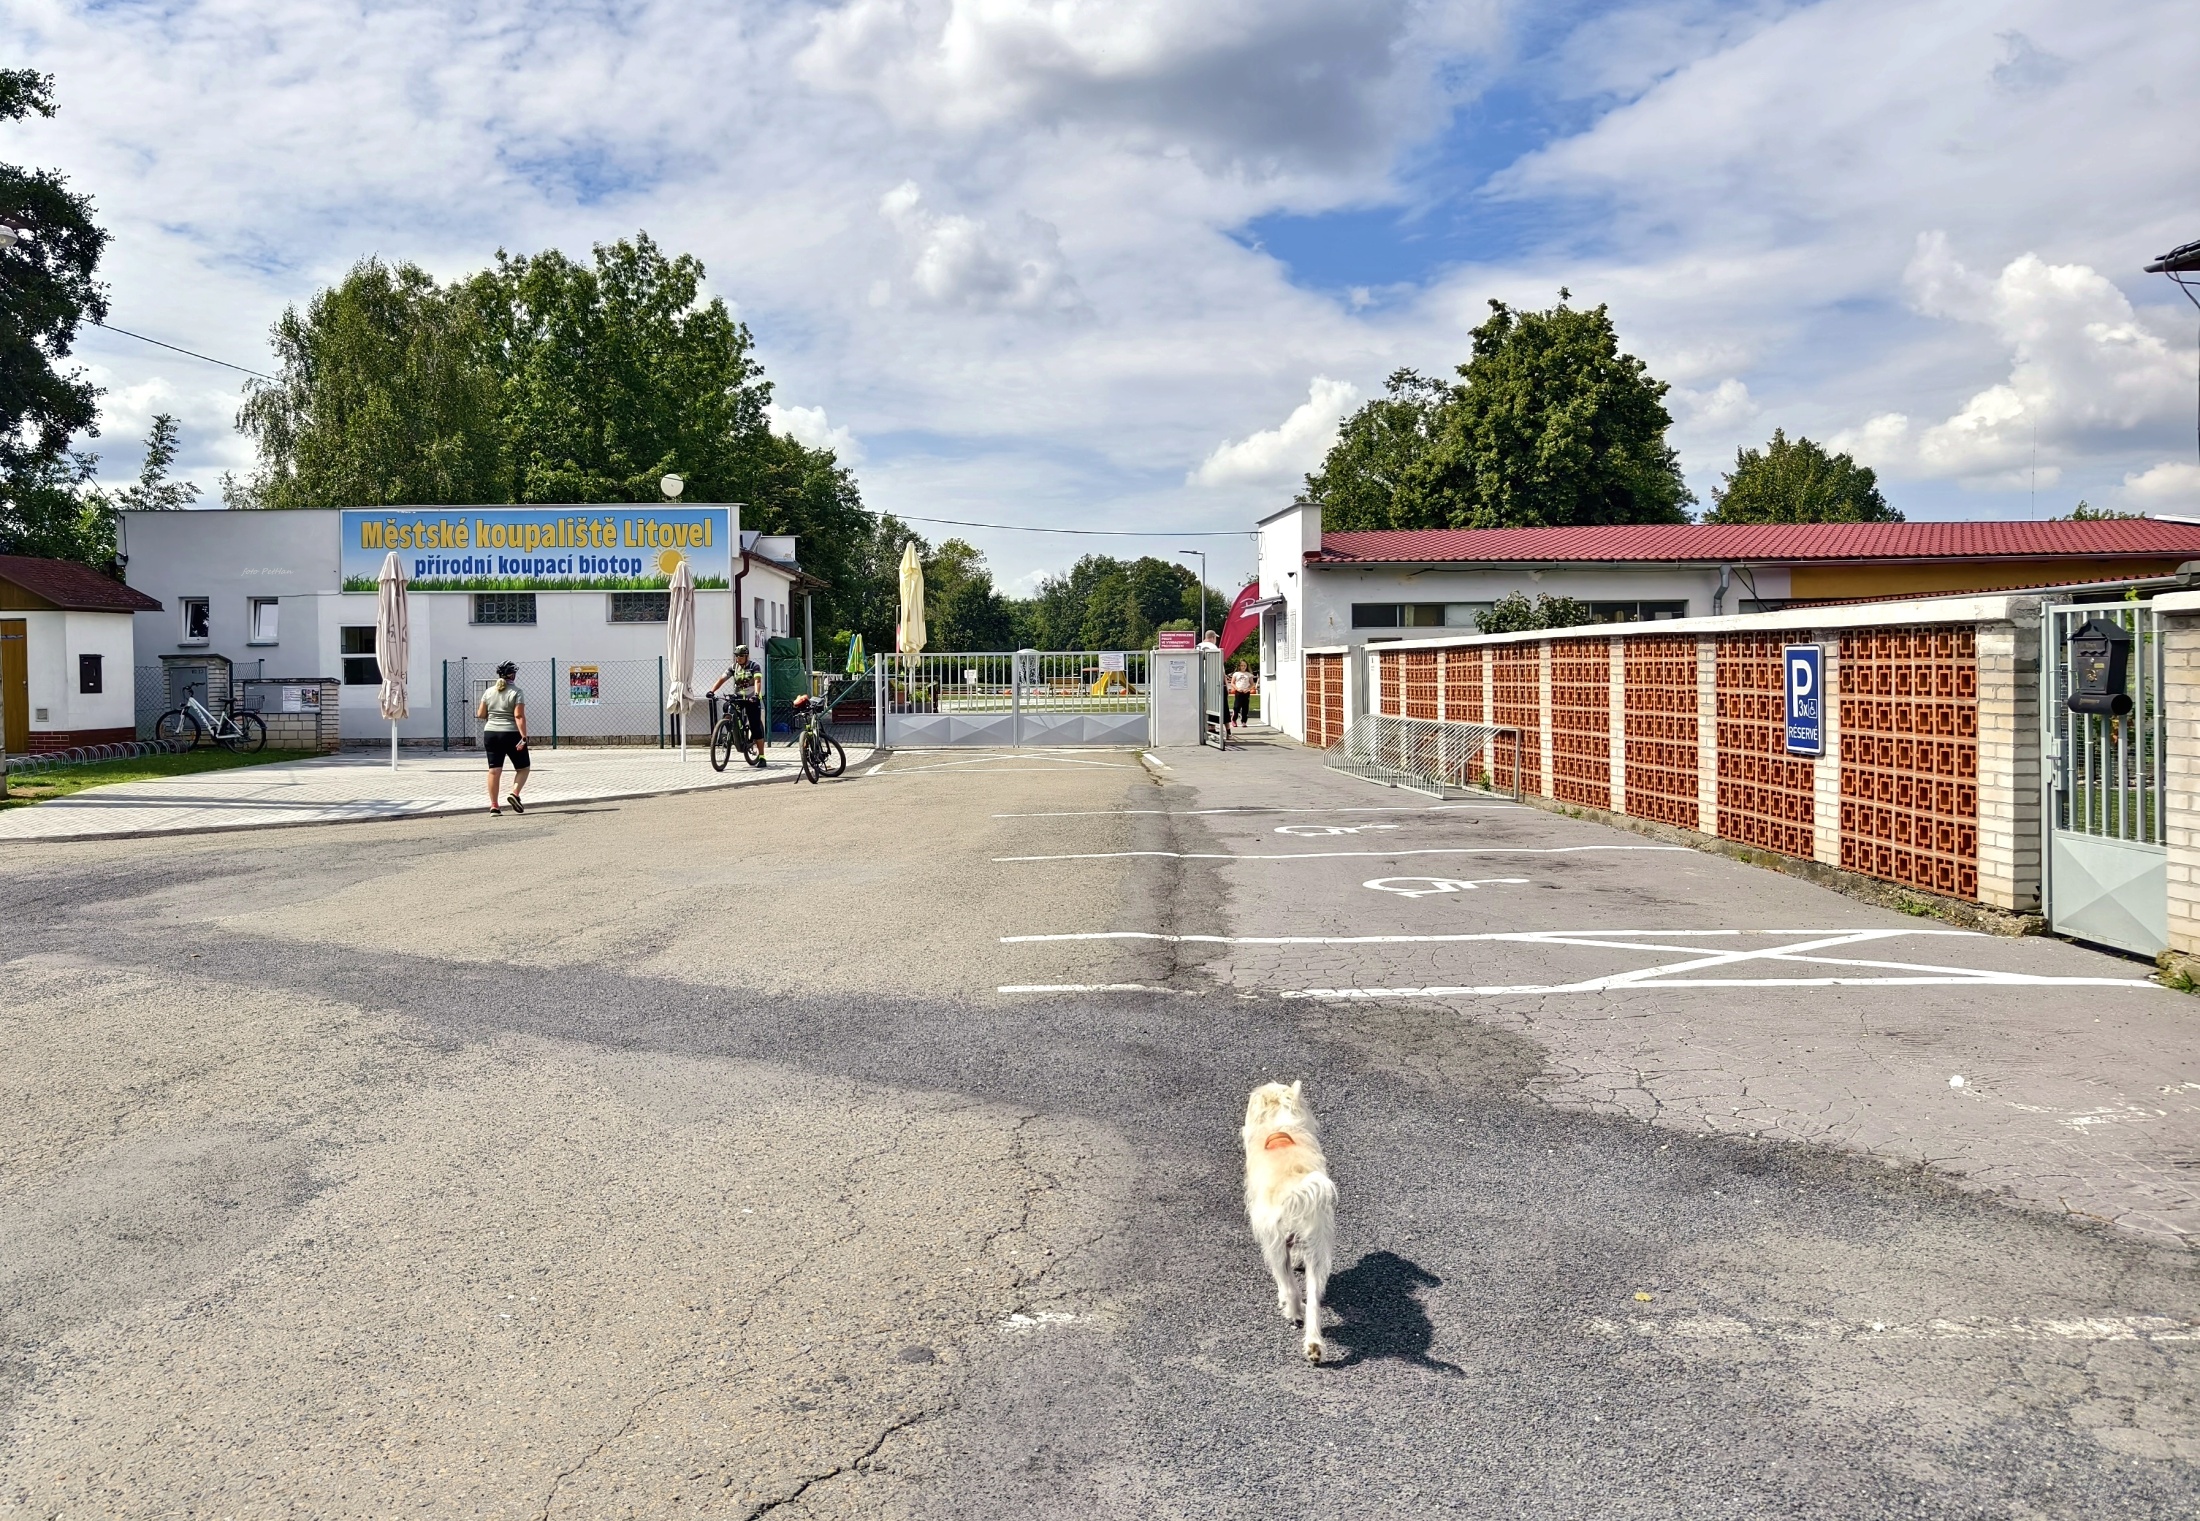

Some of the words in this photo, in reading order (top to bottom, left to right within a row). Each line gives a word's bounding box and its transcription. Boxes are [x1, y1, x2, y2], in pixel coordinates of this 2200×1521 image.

[361, 517, 469, 549] Městské
[476, 516, 618, 552] koupaliště
[624, 518, 712, 547] Litovel
[415, 554, 492, 578] přírodní
[498, 554, 573, 577] koupací
[579, 555, 643, 577] biotop
[1792, 660, 1812, 717] P
[1798, 699, 1808, 717] 3x
[1789, 724, 1818, 740] RÉSERVÉ
